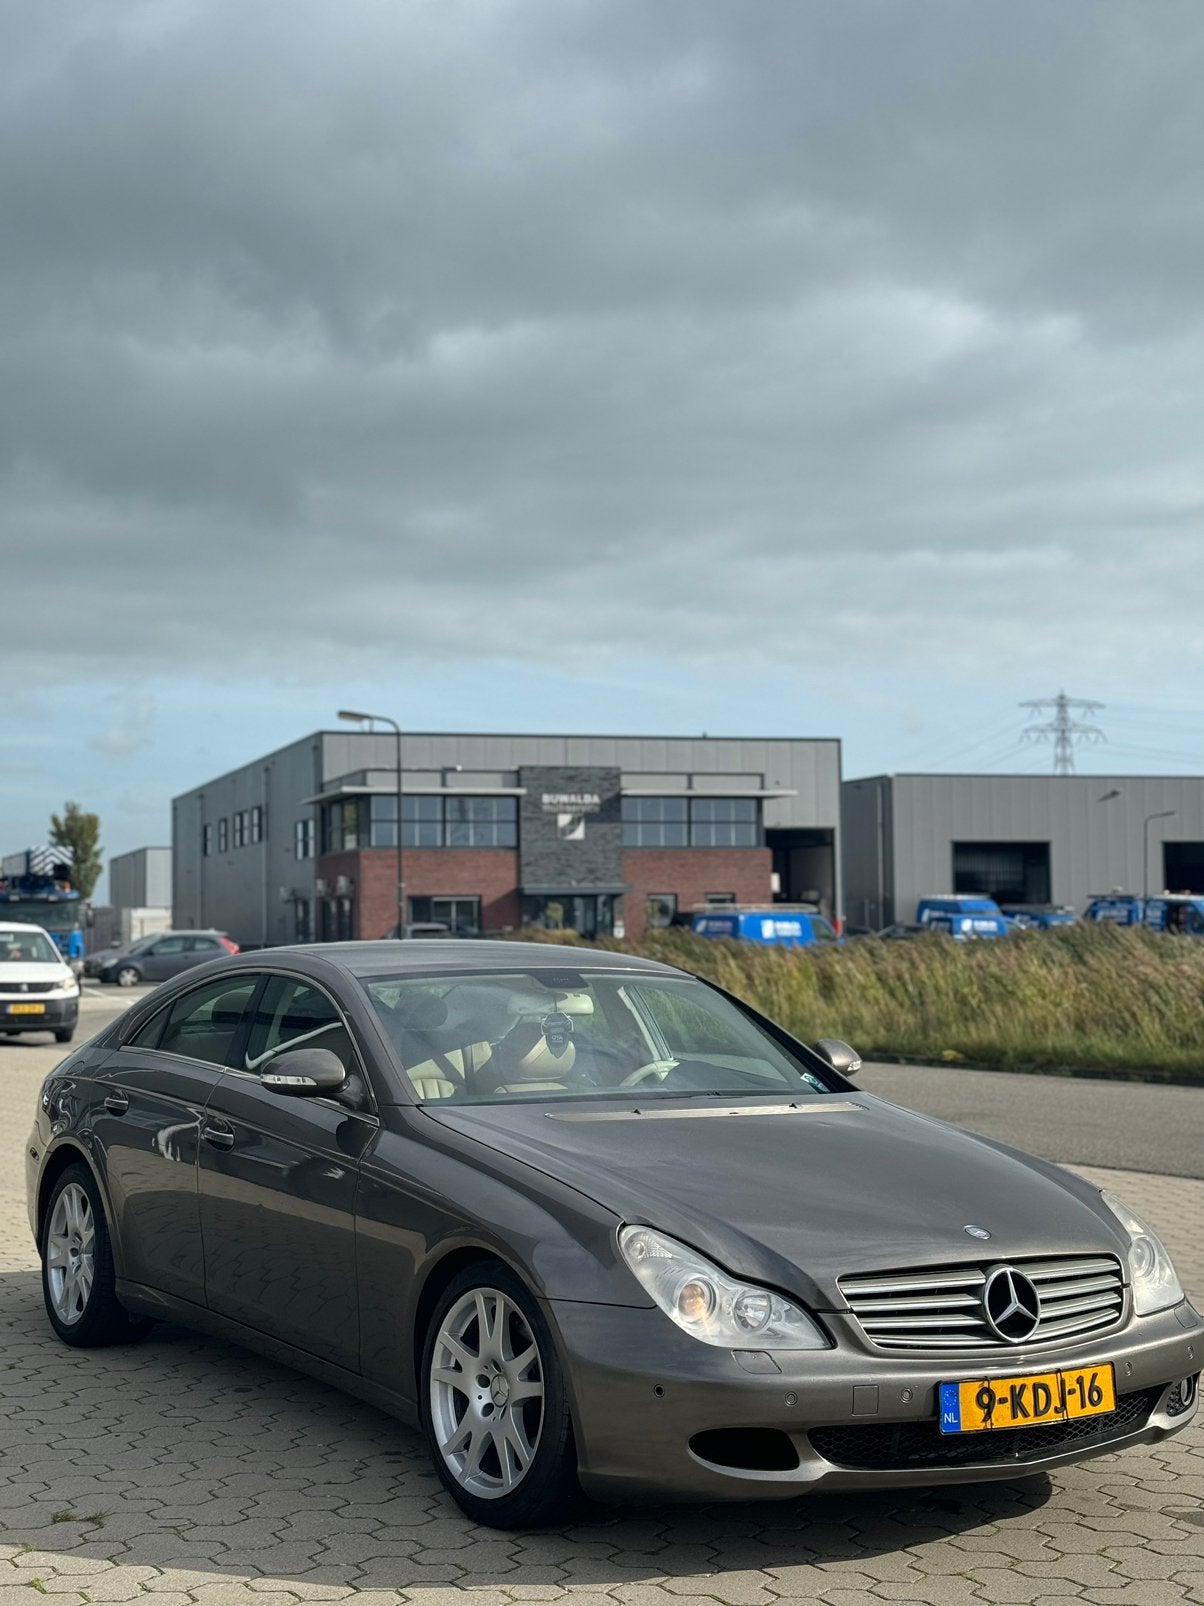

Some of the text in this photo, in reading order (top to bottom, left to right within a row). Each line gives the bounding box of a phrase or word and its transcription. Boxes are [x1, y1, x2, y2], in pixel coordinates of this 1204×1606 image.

[541, 793, 600, 804] BUWALDA
[944, 1373, 1103, 1424] NL 9-KDJ-16
